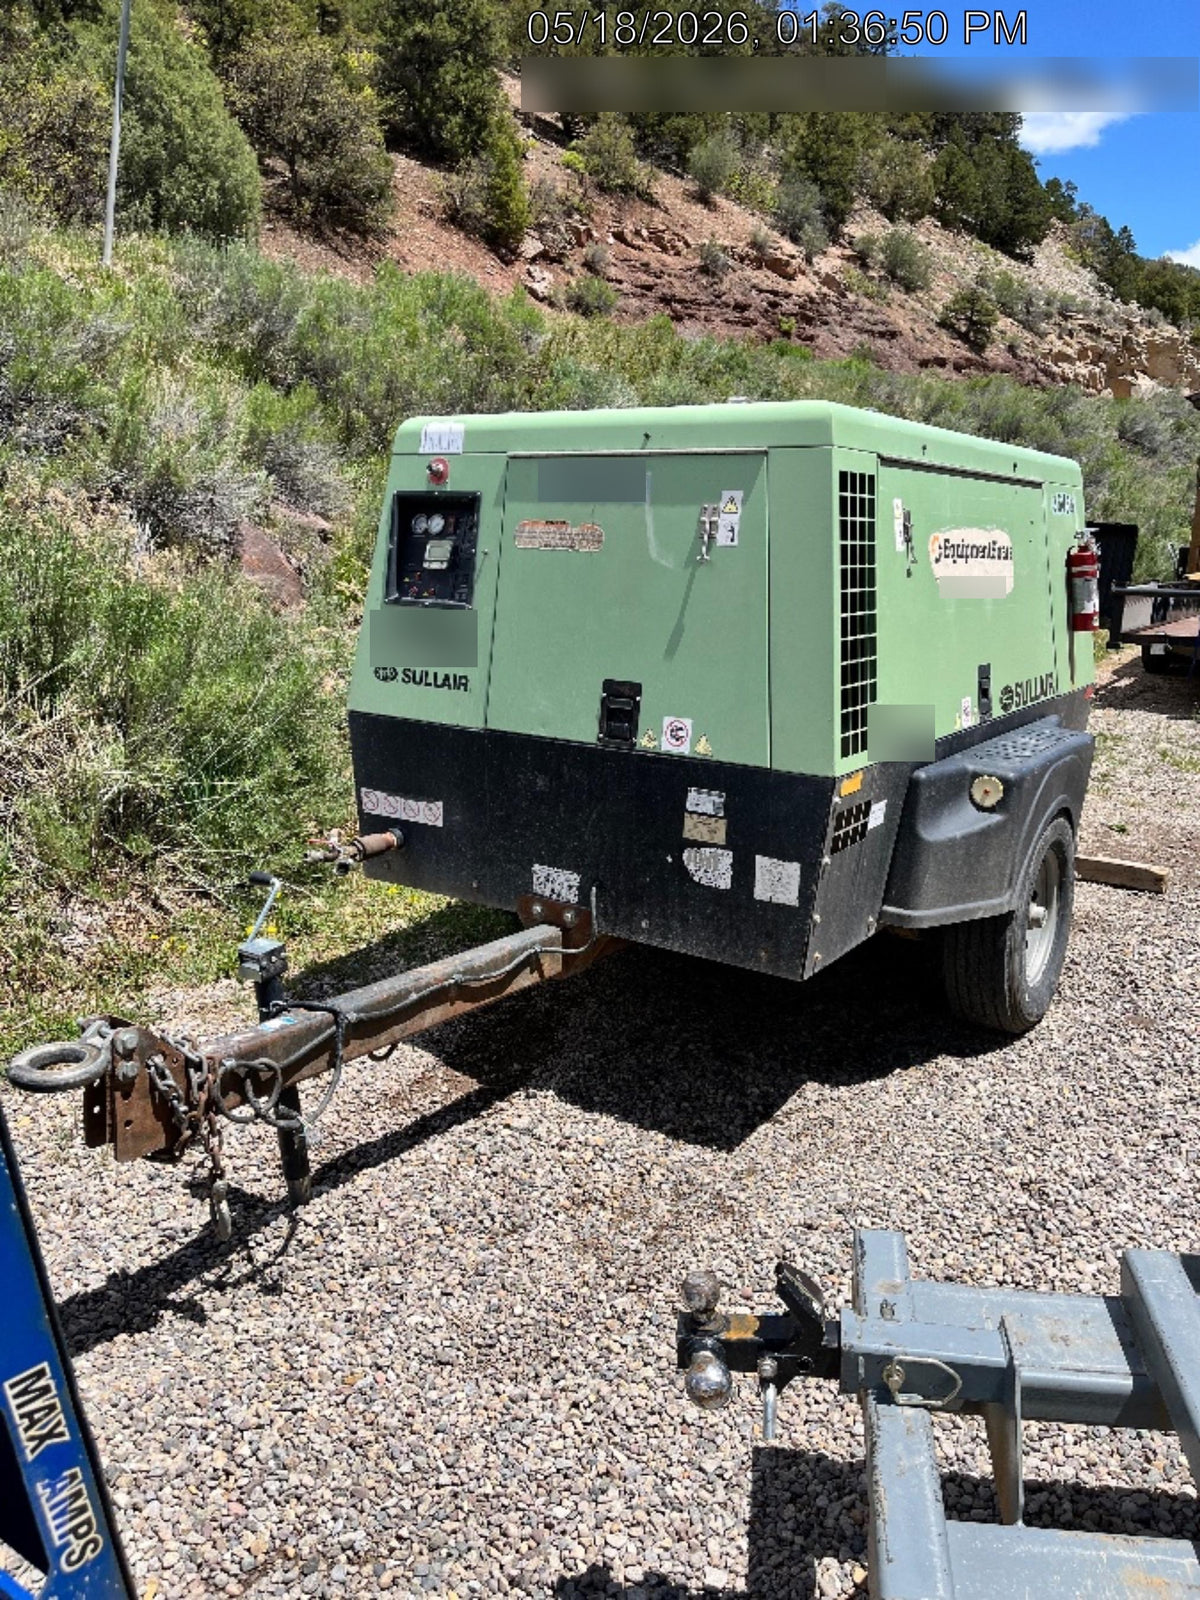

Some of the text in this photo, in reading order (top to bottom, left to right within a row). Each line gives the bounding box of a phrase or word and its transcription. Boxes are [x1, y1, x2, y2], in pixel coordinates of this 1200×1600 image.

[401, 667, 470, 692] SULLAIR
[1015, 671, 1056, 708] SULLAIR
[3, 1361, 103, 1573] MAX AMPS
